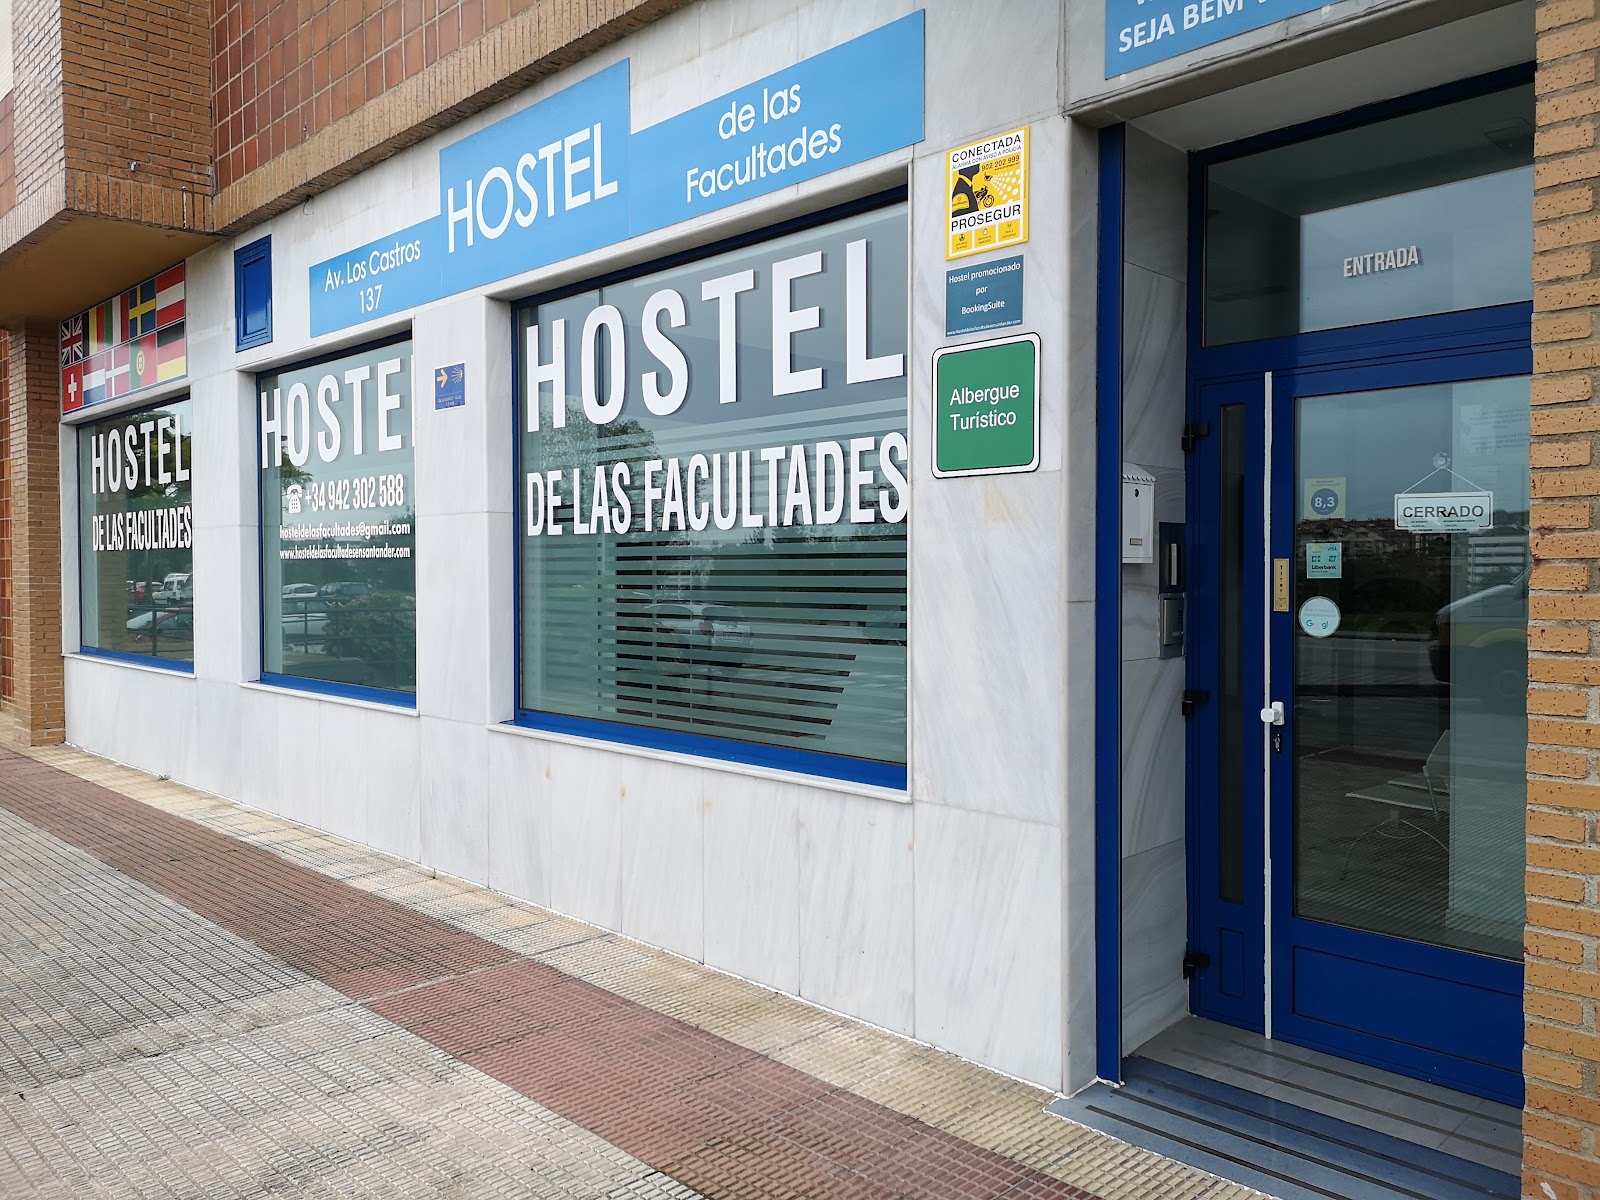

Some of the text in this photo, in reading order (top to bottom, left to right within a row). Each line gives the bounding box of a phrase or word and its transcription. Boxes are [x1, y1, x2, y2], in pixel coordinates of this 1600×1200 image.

[1119, 0, 1243, 53] SEJA BEM
[718, 83, 801, 140] de las
[686, 123, 842, 203] Facultades
[952, 134, 1021, 163] CONECTADA
[981, 163, 993, 171] 902
[994, 159, 1007, 168] 202
[1007, 154, 1020, 164] 999
[447, 122, 618, 254] HOSTEL
[951, 204, 1021, 232] PROSEGUR
[325, 240, 421, 292] Av. Los Castros
[948, 261, 1021, 284] Hostel promocionado
[1343, 245, 1419, 278] ENTRADA
[359, 284, 383, 314] 137
[975, 286, 988, 296] por
[961, 300, 1006, 315] BookingSuite
[526, 238, 904, 433] HOSTEL
[949, 382, 1020, 406] Albergue
[950, 407, 1017, 431] Turístico
[91, 414, 190, 495] HOSTEL
[305, 473, 404, 512] +34 942 302 588
[526, 431, 908, 537] DE LAS FACULTADES
[1314, 496, 1335, 509] 8,3
[1403, 505, 1484, 518] CERRADO
[92, 505, 192, 551] DE LAS FACULTADES
[279, 520, 411, 539] hosteldelasfacultades@gmail.com
[279, 542, 411, 559] www.hosteldelasfacultadesensantander.com
